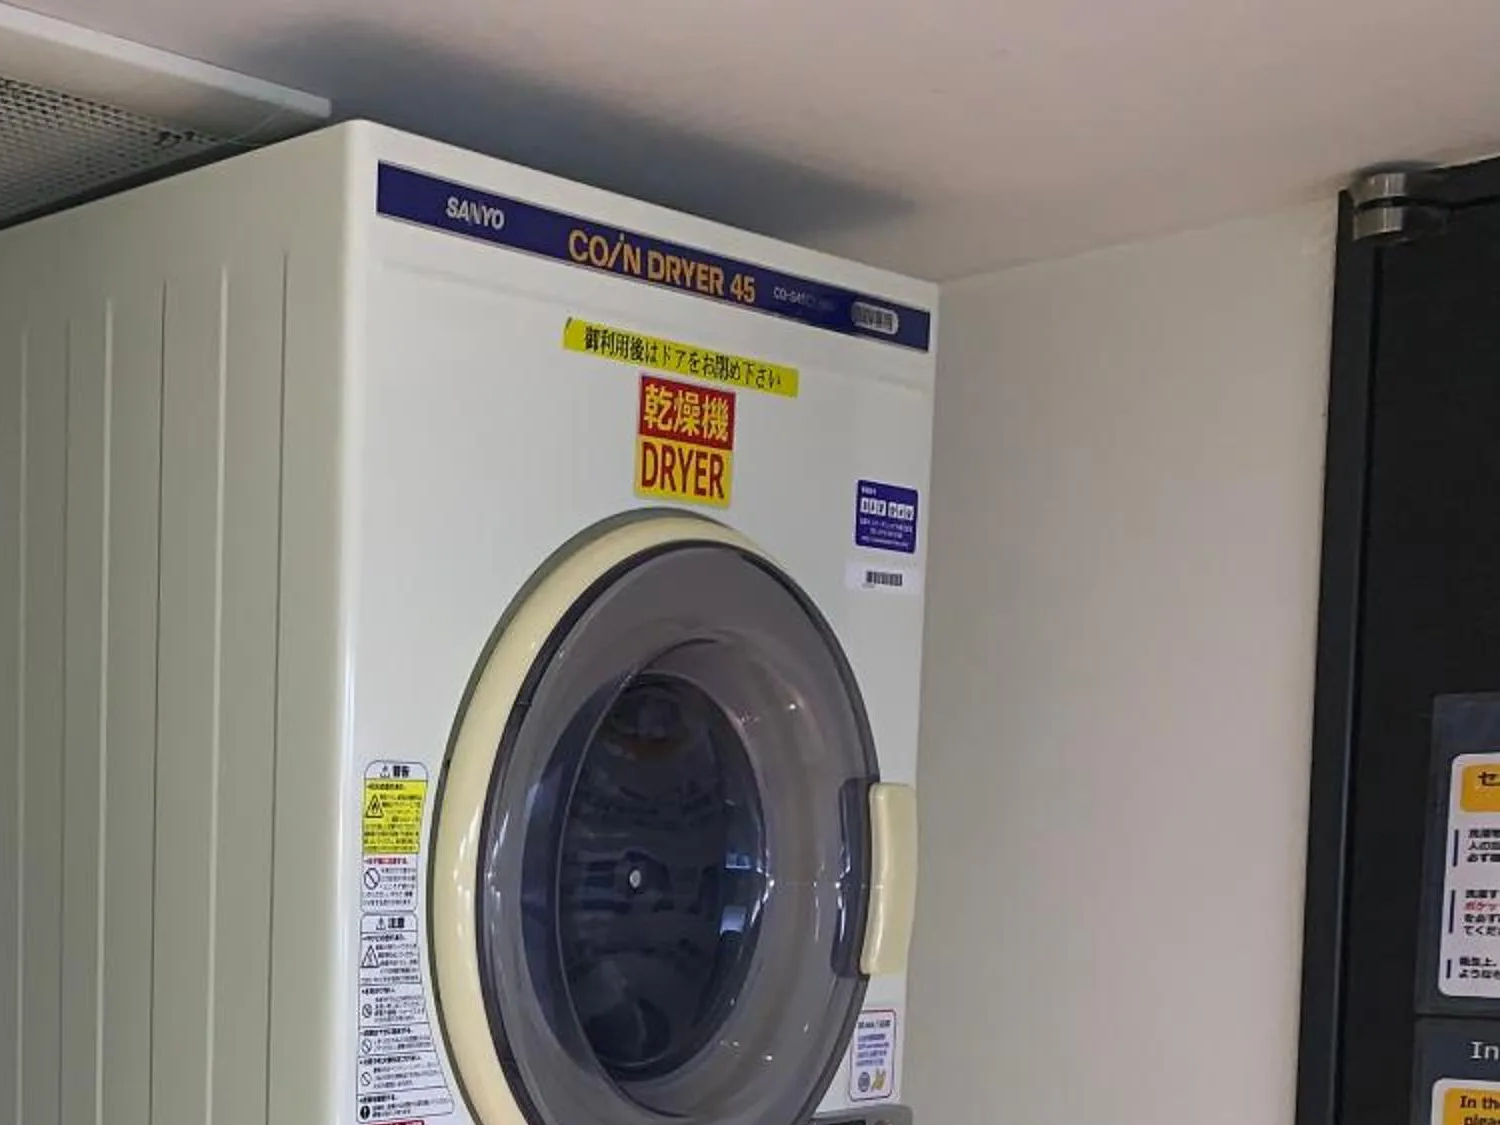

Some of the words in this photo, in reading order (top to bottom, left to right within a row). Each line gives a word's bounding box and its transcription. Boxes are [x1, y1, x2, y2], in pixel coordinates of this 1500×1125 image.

[445, 196, 505, 231] SANYO
[567, 228, 641, 276] COIN
[647, 251, 725, 297] DRYER
[730, 272, 756, 304] 45
[584, 324, 782, 389] 御利用後はドアをお閉め下さい
[643, 383, 730, 443] 乾燥機
[641, 441, 725, 500] DRYER
[1471, 1041, 1499, 1060] In
[1460, 1095, 1477, 1109] In
